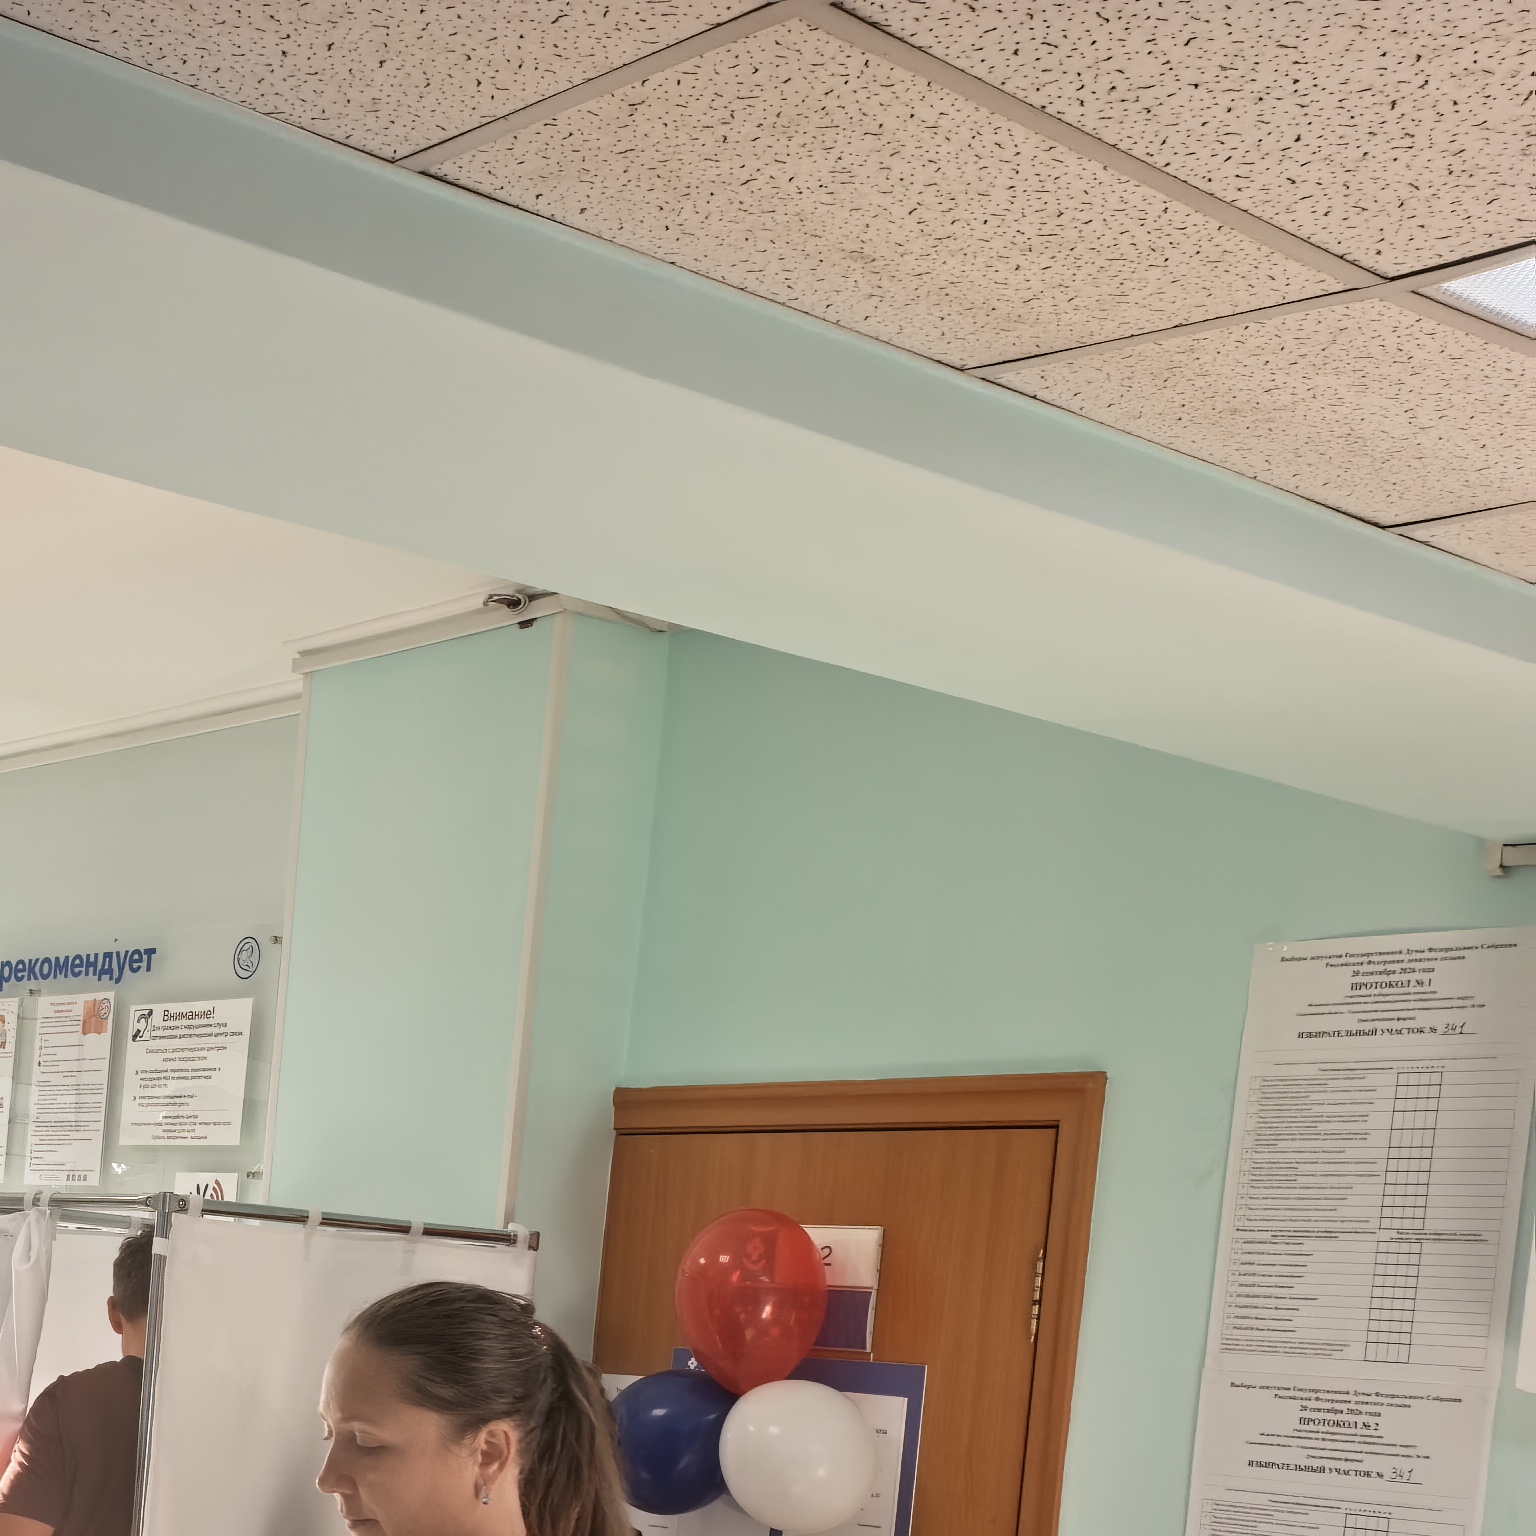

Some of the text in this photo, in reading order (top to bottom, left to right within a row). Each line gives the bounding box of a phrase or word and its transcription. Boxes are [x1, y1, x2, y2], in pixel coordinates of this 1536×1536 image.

[1350, 980, 1411, 991] ПРОТОКОЛ
[162, 1006, 215, 1022] Внимание!
[1297, 1027, 1378, 1039] ИЗБИРАТЕЛЬНЫЙ
[1379, 1026, 1426, 1036] УЧАСТОК
[1442, 1022, 1466, 1035] 341
[1298, 1416, 1358, 1430] ПРОТОКОЛ
[1248, 1459, 1326, 1474] ИЗБИРАТЕЛЬНЫЙ
[1328, 1466, 1376, 1479] УЧАСТОК
[1389, 1466, 1414, 1481] 341
